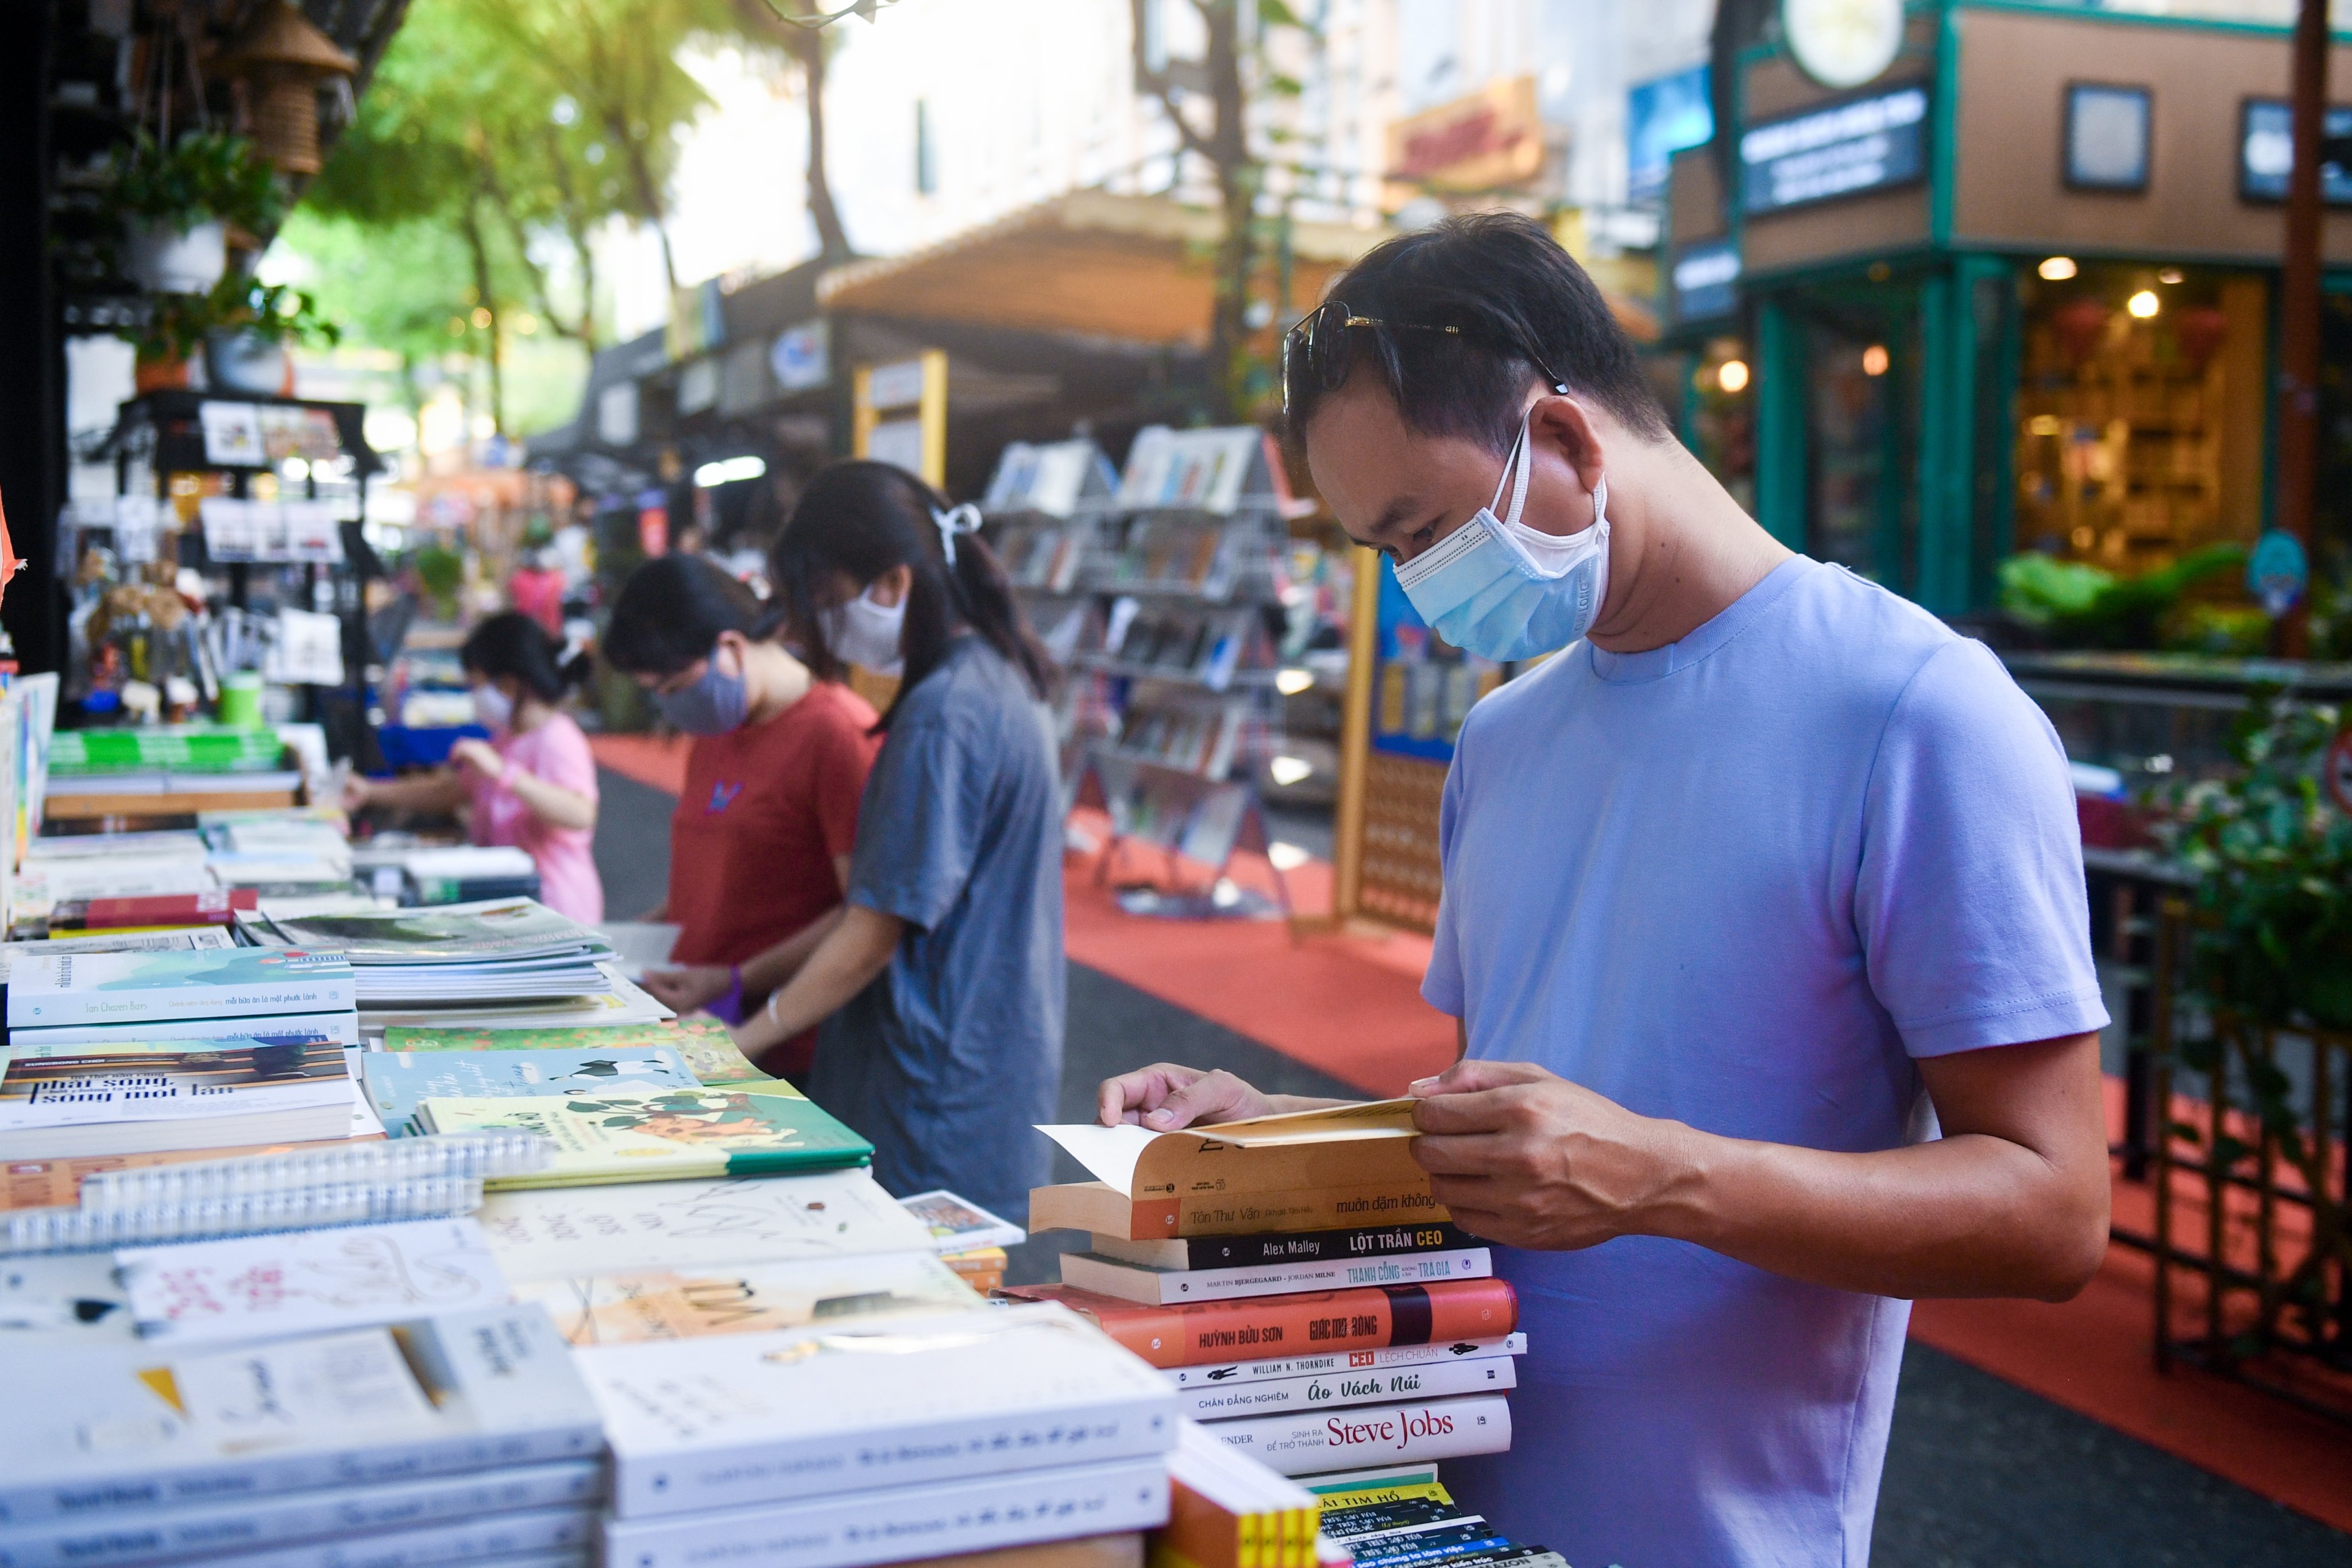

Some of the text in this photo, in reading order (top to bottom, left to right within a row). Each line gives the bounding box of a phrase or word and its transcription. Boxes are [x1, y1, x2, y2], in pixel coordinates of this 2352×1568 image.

[1336, 1192, 1436, 1215] muôn dặm không
[1191, 1205, 1260, 1224] Tôn Thư Vân
[1263, 1239, 1320, 1256] Alex Malley
[1349, 1227, 1442, 1255] LỘT TRẦN CEO
[1378, 1261, 1400, 1281] CÔNG
[1206, 1280, 1233, 1288] MARTIN
[1288, 1273, 1314, 1282] JORDAN
[1199, 1324, 1283, 1348] HUỲNH BỬU SƠN
[1348, 1344, 1439, 1368] CEO LỆCH CHUẨN
[1252, 1357, 1335, 1375] WILLIAM N. THORNDIKE
[1307, 1373, 1422, 1401] Áo Vách Núi
[1198, 1396, 1225, 1409] CHÂN
[1254, 1390, 1289, 1404] NGHIÊM
[1291, 1428, 1324, 1440] SINH RA
[1327, 1407, 1454, 1450] Steve Jobs
[1215, 1434, 1254, 1447] ENDER
[1266, 1436, 1324, 1452] ĐỂ TRỞ THÀNH
[1318, 1497, 1338, 1509] ÁI
[1342, 1495, 1373, 1506] TIM
[1377, 1553, 1410, 1566] chúng
[1409, 1552, 1422, 1561] ta
[1472, 1557, 1531, 1568] MAZON
